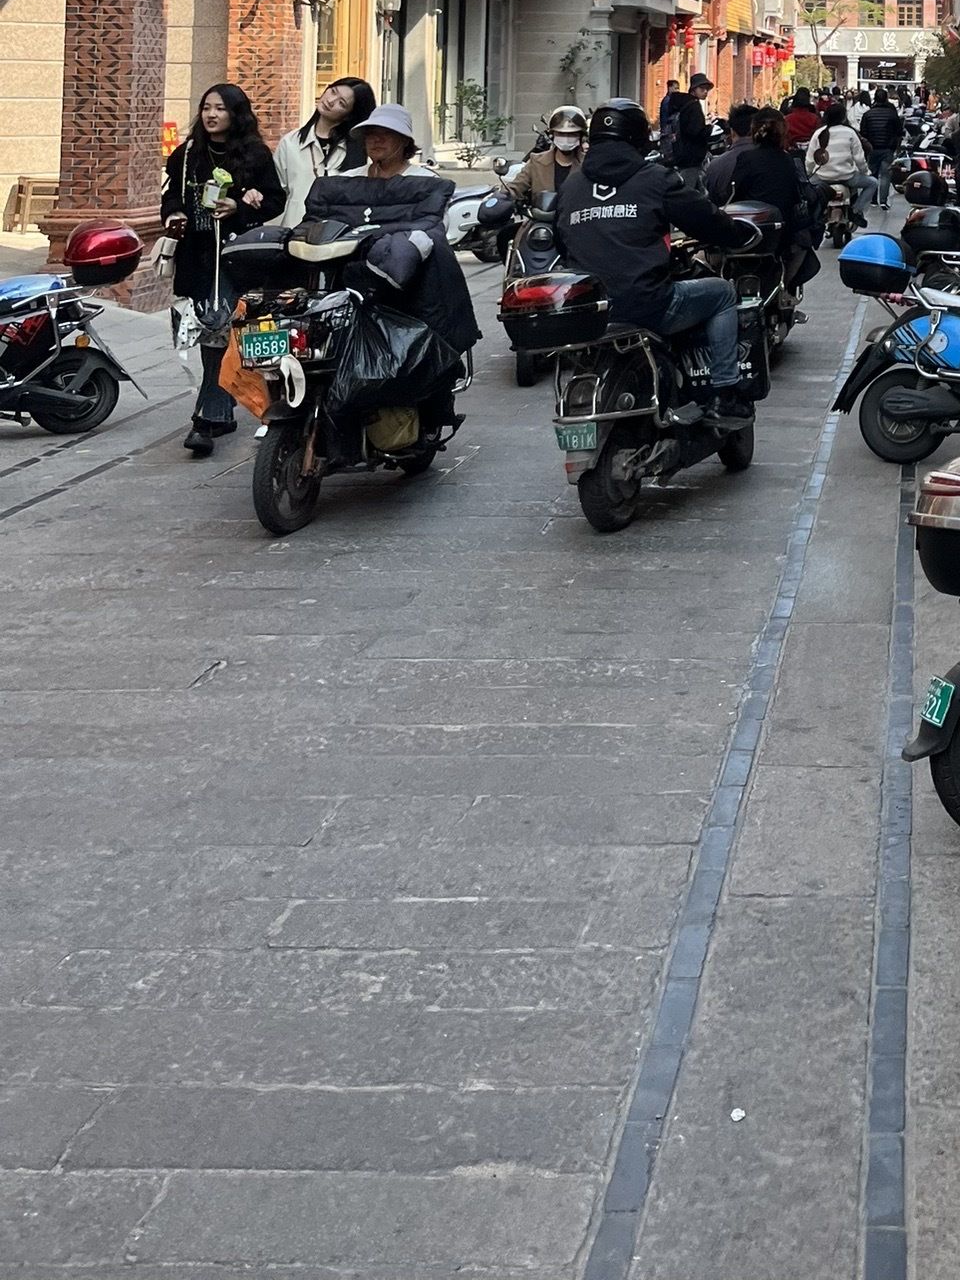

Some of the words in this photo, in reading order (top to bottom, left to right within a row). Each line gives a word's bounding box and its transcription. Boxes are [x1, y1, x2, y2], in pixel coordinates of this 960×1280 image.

[570, 204, 638, 225] 顺丰同城急送
[246, 339, 287, 356] H8589
[690, 366, 711, 377] luck
